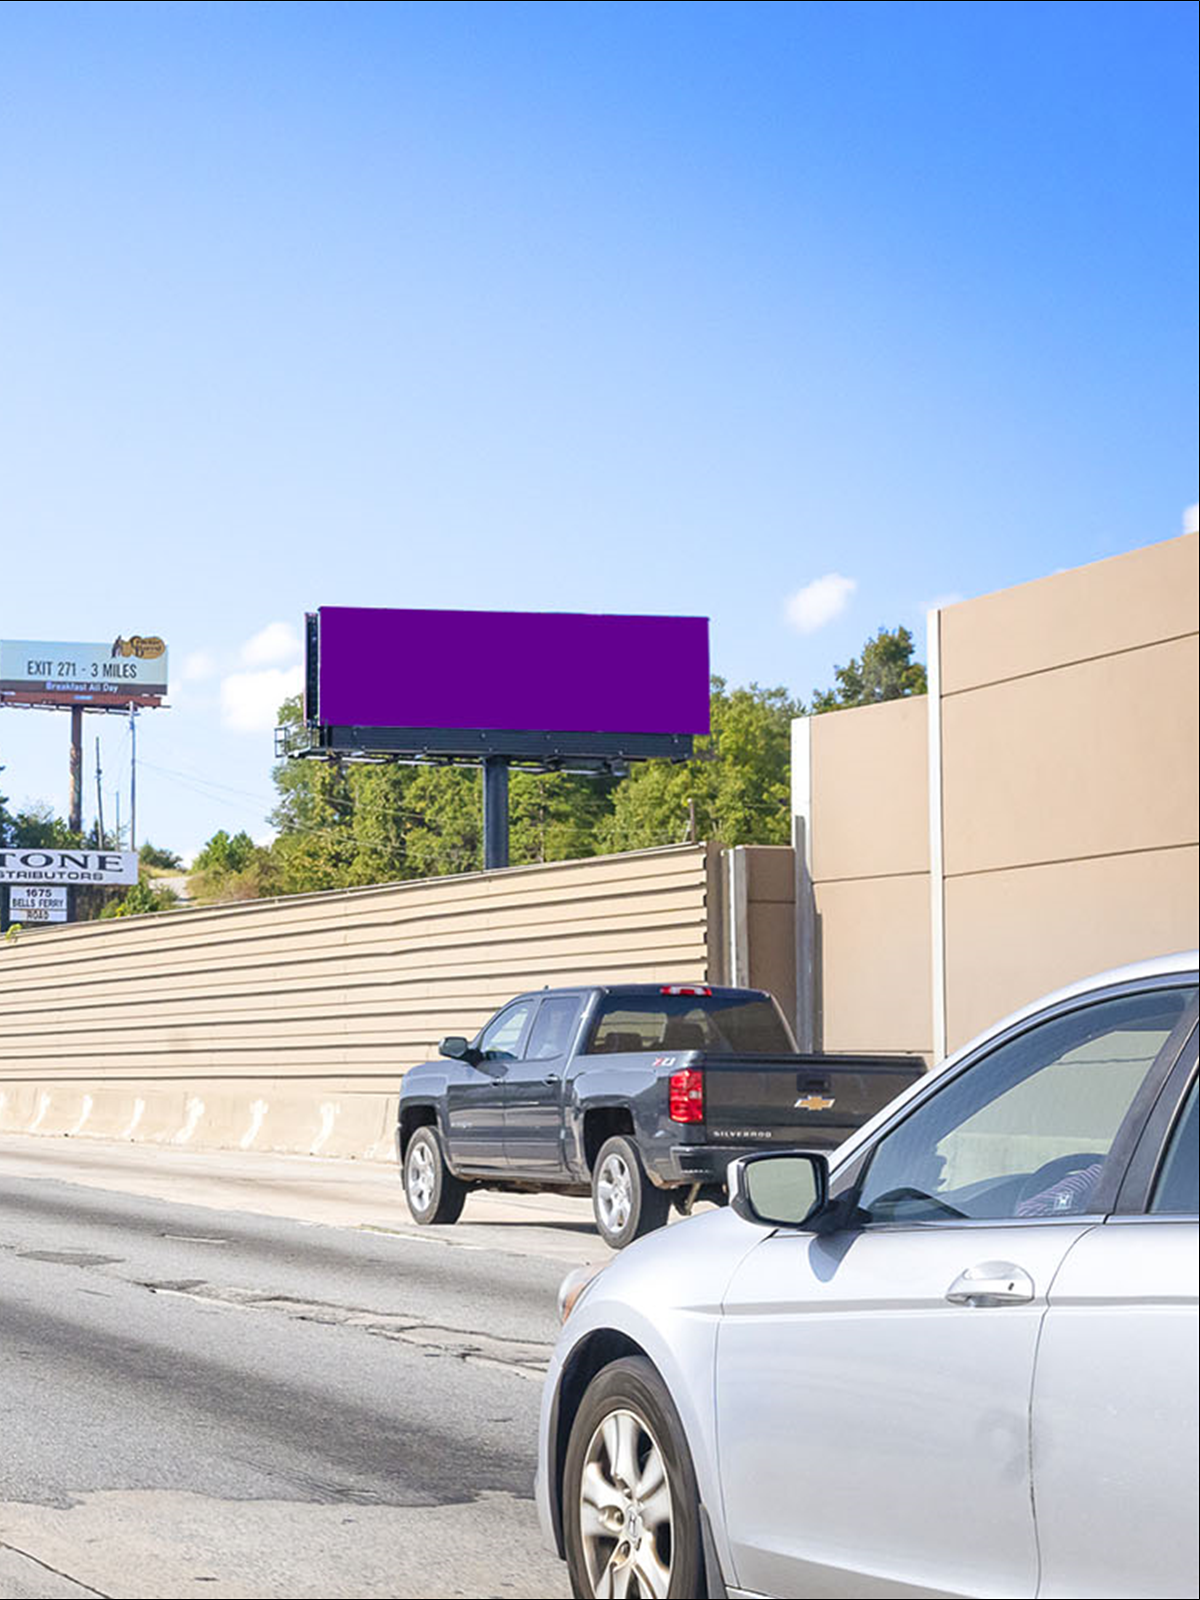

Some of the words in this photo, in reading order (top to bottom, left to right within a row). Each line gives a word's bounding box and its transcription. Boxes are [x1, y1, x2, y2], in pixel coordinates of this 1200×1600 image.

[27, 660, 53, 676] EXIT
[57, 661, 77, 677] 271
[90, 663, 99, 678] 3
[102, 663, 138, 679] MILES
[46, 681, 87, 691] Breakfast
[103, 683, 119, 694] Day
[26, 888, 52, 898] 1675
[12, 898, 36, 908] BELLS
[38, 898, 64, 909] FERRY
[27, 910, 50, 920] ROAD
[713, 1130, 772, 1139] SILVERADO
